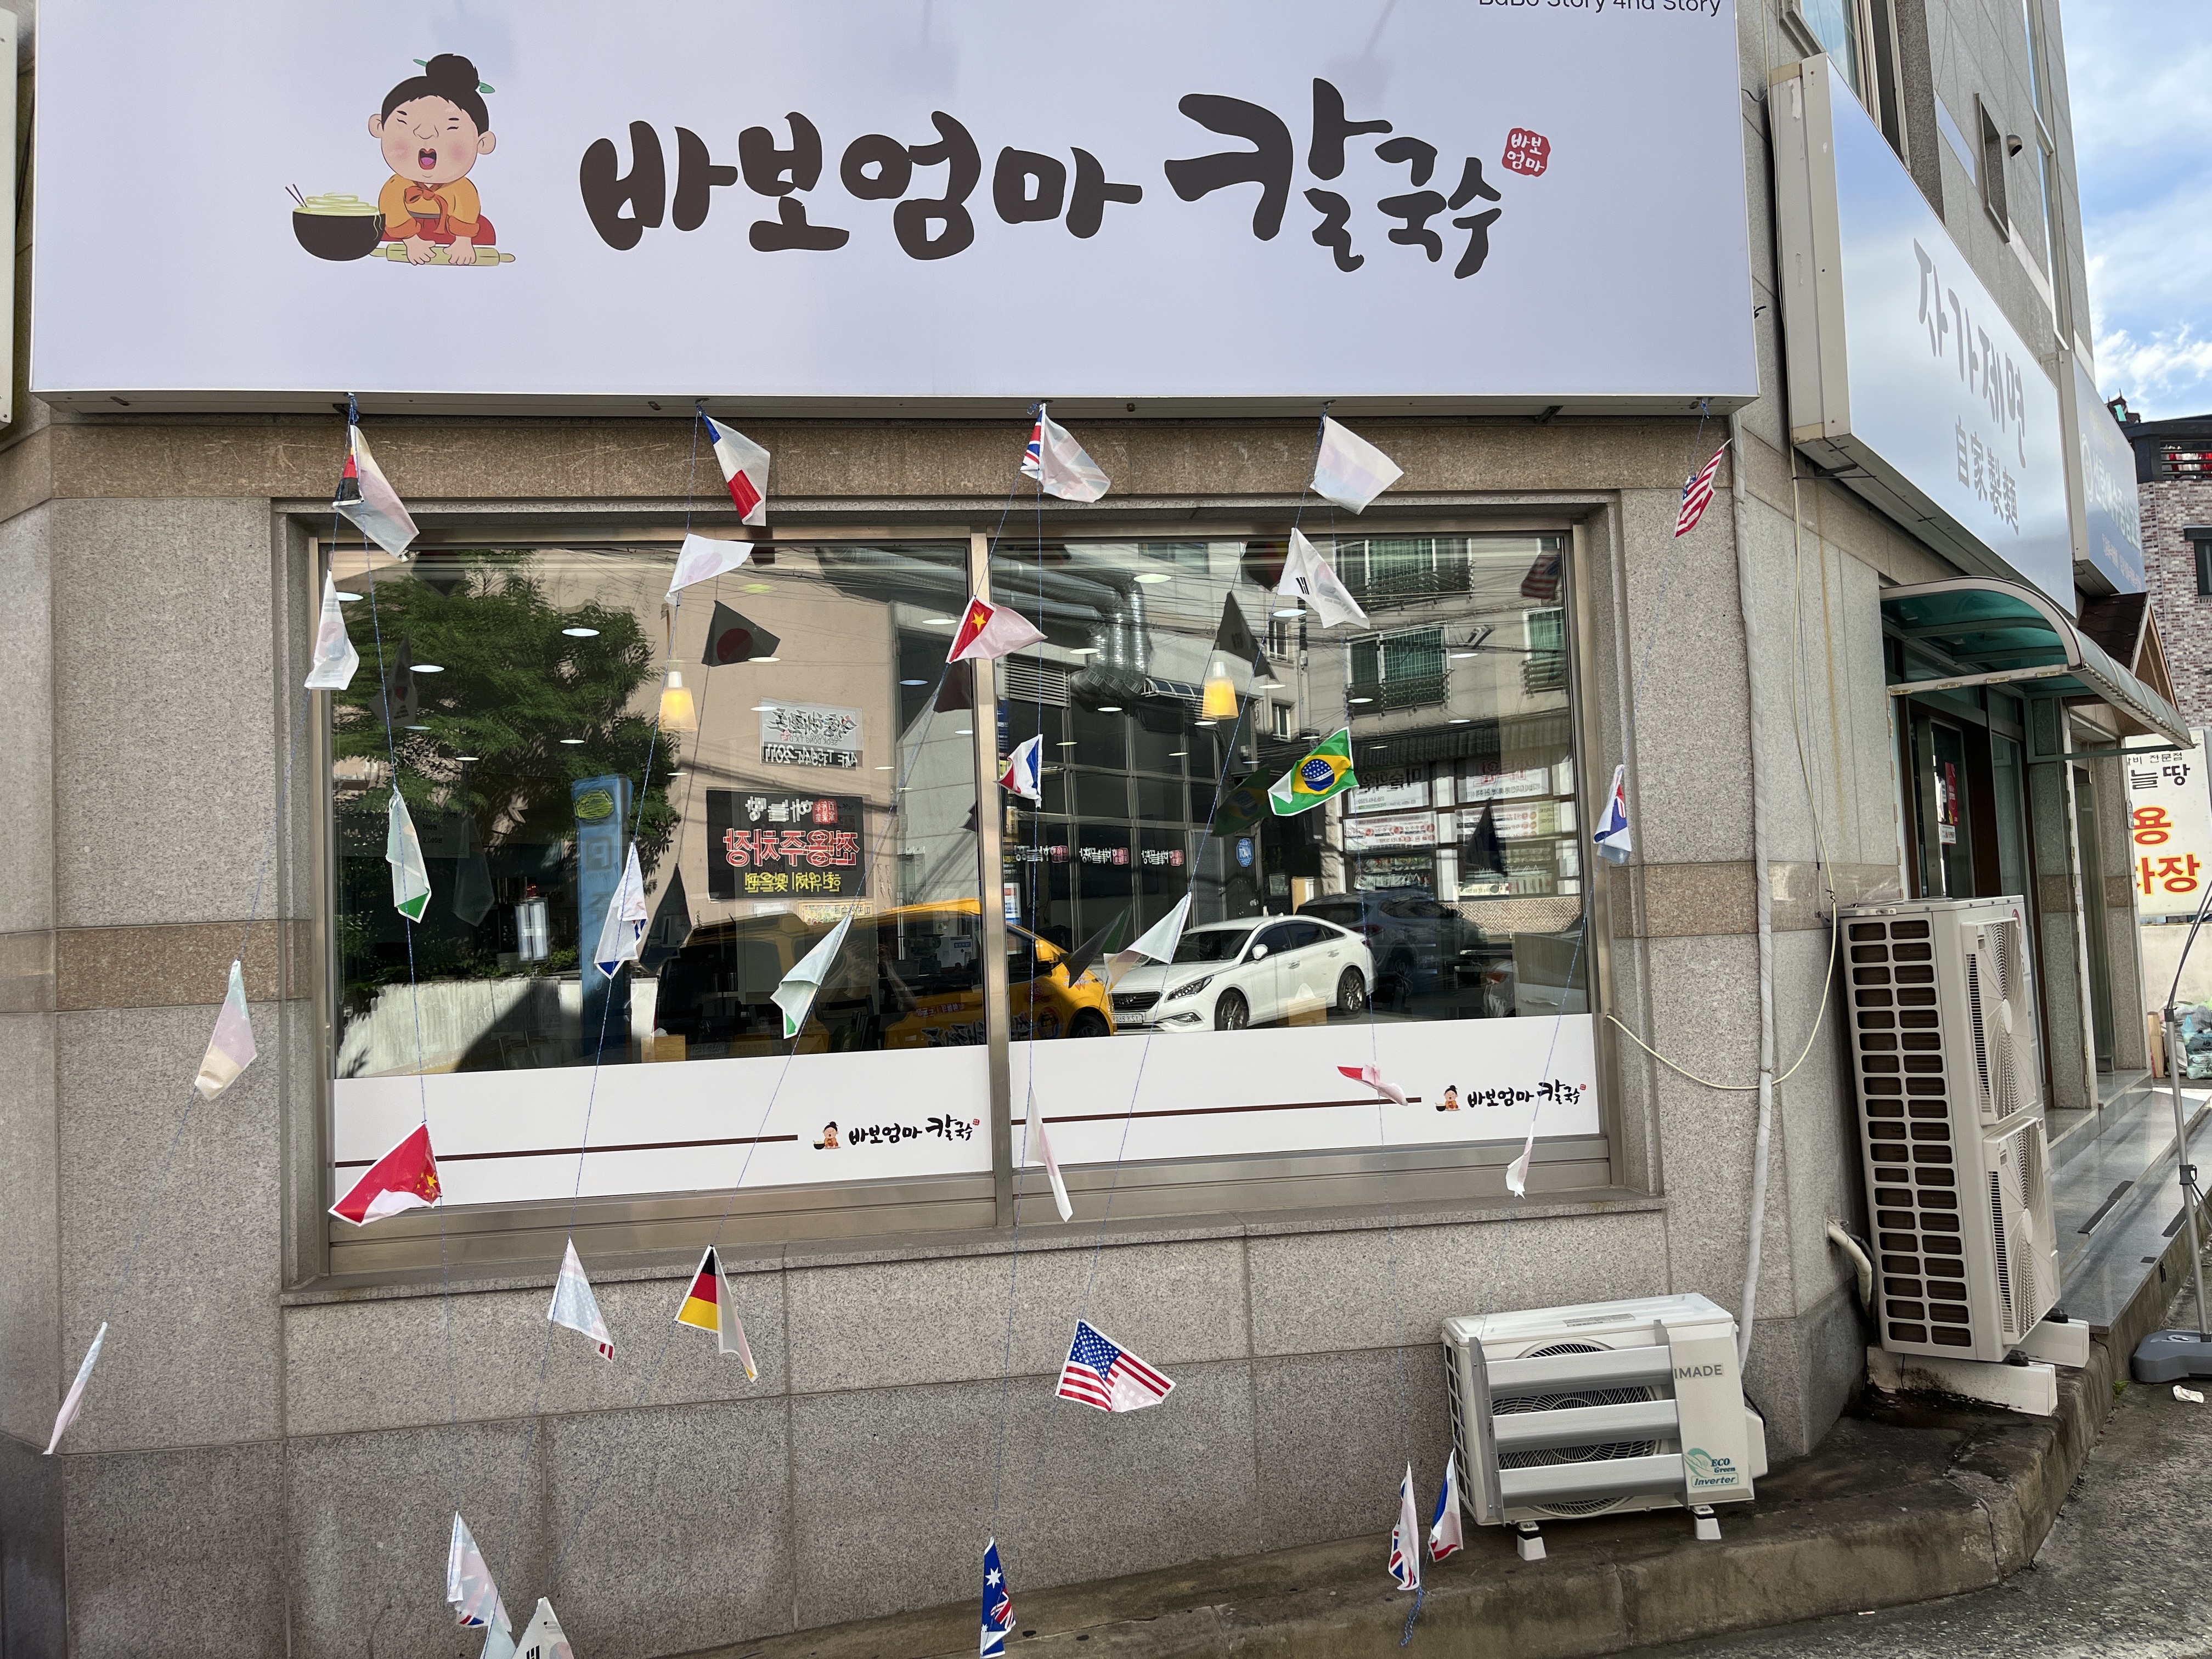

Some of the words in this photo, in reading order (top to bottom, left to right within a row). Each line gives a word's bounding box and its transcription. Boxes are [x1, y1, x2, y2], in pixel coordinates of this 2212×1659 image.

[1663, 0, 1720, 17] Story
[1510, 133, 1542, 155] 바보
[1506, 149, 1544, 172] 엄마
[580, 111, 1143, 261] 바보엄마
[1164, 77, 1502, 279] 칼국수
[1913, 237, 2027, 469] 자가제면
[2150, 752, 2182, 763] 전문점
[2130, 764, 2191, 789] 늘땅
[2133, 807, 2171, 845] 용
[1468, 1087, 1534, 1108] 바보엄마
[1537, 1079, 1580, 1105] 칼국수
[849, 1123, 923, 1146] 바보엄마
[926, 1114, 973, 1141] 칼국수
[1674, 1364, 1723, 1379] IMADE
[1711, 1458, 1730, 1467] ECO
[1694, 1476, 1736, 1486] Inverter
